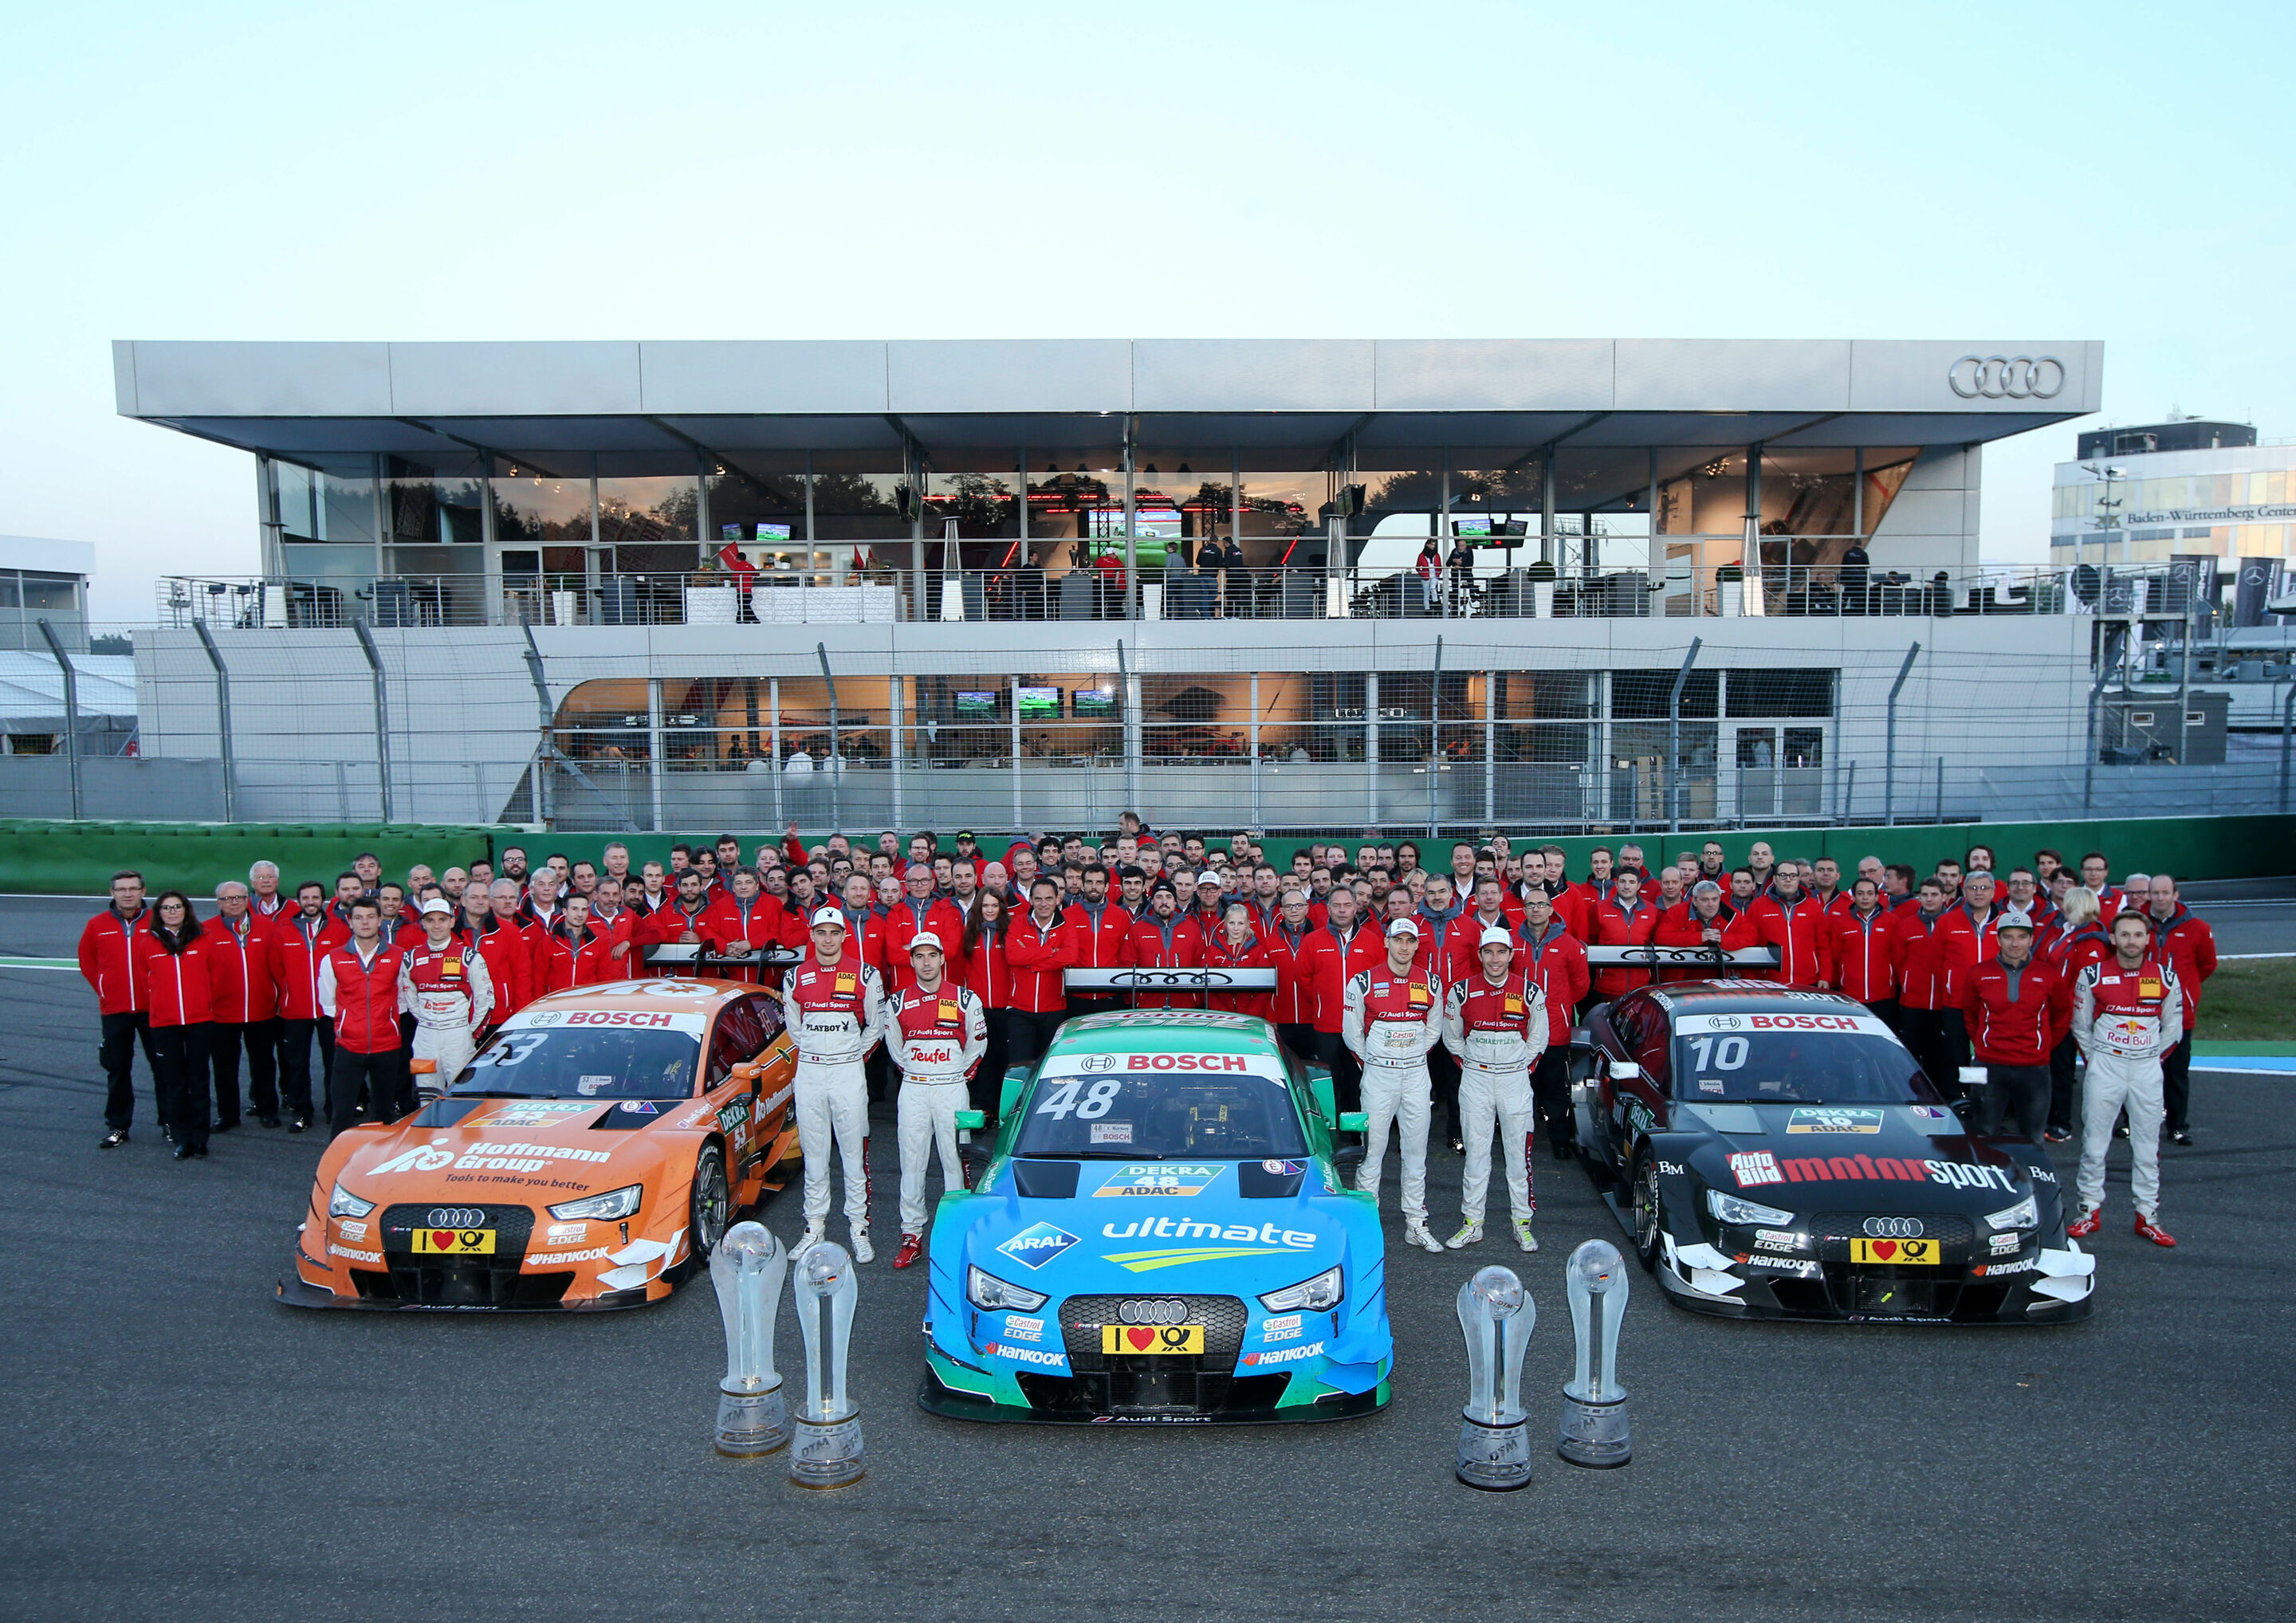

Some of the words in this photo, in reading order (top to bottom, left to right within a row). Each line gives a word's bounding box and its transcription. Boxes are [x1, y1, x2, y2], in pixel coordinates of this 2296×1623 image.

[2128, 507, 2255, 525] Baden-Württemberg
[940, 1000, 957, 1008] ADAC
[1506, 993, 1523, 1002] ADAC
[1783, 991, 1849, 1004] sport
[566, 1012, 673, 1028] BOSCH
[1071, 1019, 1255, 1032] EDGE
[1751, 1016, 1860, 1031] BOSCH
[1392, 1031, 1415, 1039] Castrol
[2107, 1032, 2130, 1044] Red
[2133, 1034, 2152, 1046] Bull
[469, 1032, 548, 1067] 53
[910, 1047, 951, 1064] Teufel
[1689, 1036, 1750, 1072] 10
[1127, 1055, 1247, 1071] BOSCH
[1035, 1079, 1121, 1121] 48
[513, 1103, 583, 1112] DEKRA
[505, 1111, 547, 1120] 53
[721, 1106, 747, 1131] DEKRA
[1816, 1117, 1853, 1126] 10
[734, 1123, 746, 1149] 53
[464, 1142, 611, 1163] Hoffmann
[1731, 1153, 1775, 1171] Auto
[1129, 1166, 1213, 1176] DEKRA
[1736, 1166, 1783, 1185] Bild
[1782, 1154, 1935, 1182] motor
[1924, 1159, 2018, 1194] sport
[445, 1173, 474, 1182] Tools
[478, 1174, 489, 1183] to
[492, 1174, 525, 1185] make
[525, 1177, 548, 1188] you
[550, 1179, 590, 1192] better
[1134, 1176, 1180, 1186] 48
[1121, 1186, 1178, 1195] ADAC
[340, 1231, 366, 1243] EDGE
[1102, 1216, 1317, 1248] ultimate
[1764, 1232, 1791, 1242] Castrol
[548, 1234, 587, 1245] EDGE
[1008, 1235, 1068, 1252] ARAL
[1754, 1240, 1795, 1253] EDGE
[1990, 1244, 2021, 1256] EDGE
[1496, 1299, 1513, 1310] DTM
[1014, 1318, 1041, 1330] Castrol
[1272, 1317, 1299, 1330] Castrol
[1003, 1328, 1044, 1342] EDGE
[1263, 1327, 1303, 1343] EDGE
[801, 1437, 830, 1457] DTM
